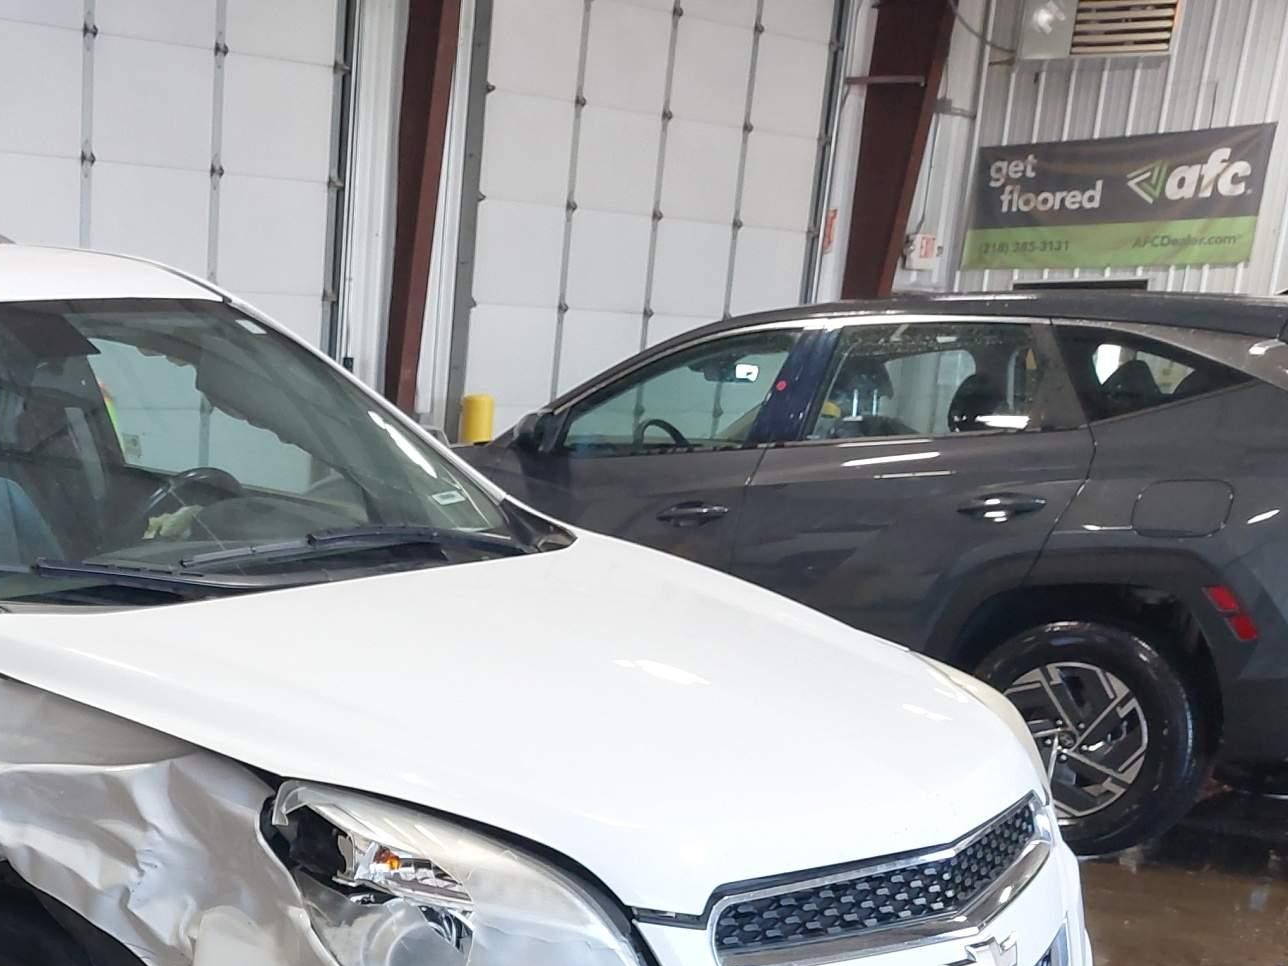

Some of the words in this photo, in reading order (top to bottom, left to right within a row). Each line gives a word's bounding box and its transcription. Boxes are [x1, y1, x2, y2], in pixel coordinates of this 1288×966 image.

[989, 154, 1038, 188] get
[1165, 147, 1252, 201] afc
[1000, 180, 1104, 213] floored
